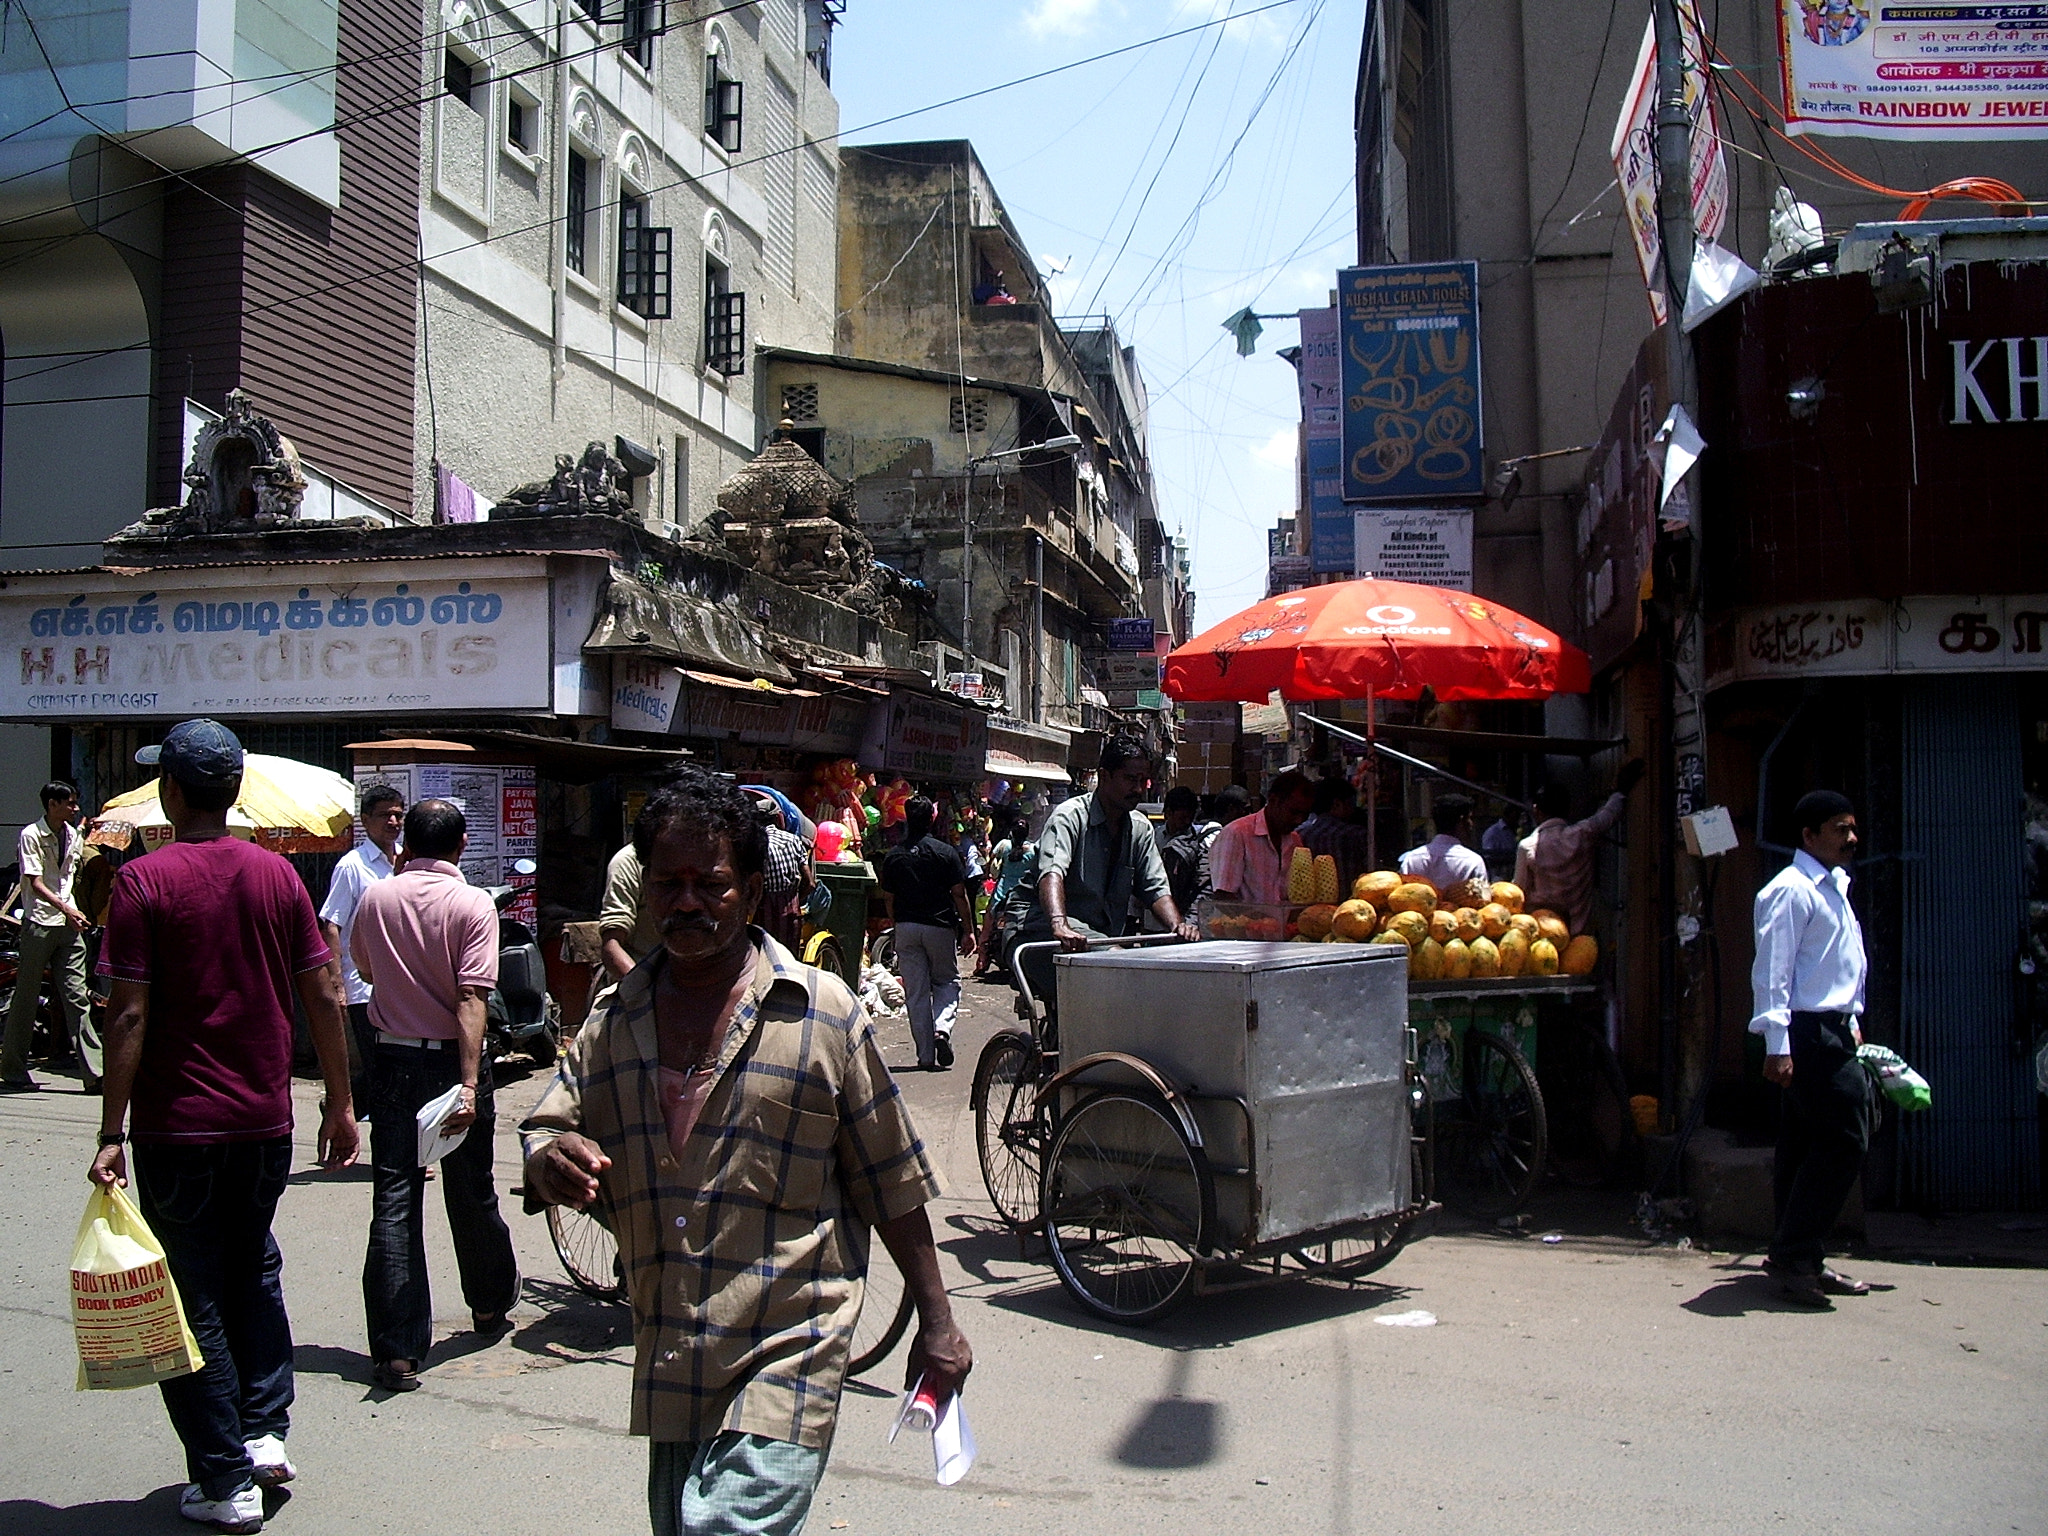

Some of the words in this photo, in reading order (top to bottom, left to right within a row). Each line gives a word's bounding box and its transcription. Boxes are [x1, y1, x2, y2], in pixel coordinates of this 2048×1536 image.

[1858, 102, 1971, 117] RAINBOW
[174, 582, 502, 636] மெடிக்கல்ஸ்
[1343, 623, 1451, 636] vodafone
[138, 629, 498, 686] Medicals
[616, 685, 668, 723] Medicals
[510, 799, 533, 809] JAVA
[72, 1269, 121, 1294] SOUTH
[122, 1260, 165, 1292] INDIA
[77, 1297, 111, 1311] BOOK
[113, 1286, 165, 1311] AGENCY
